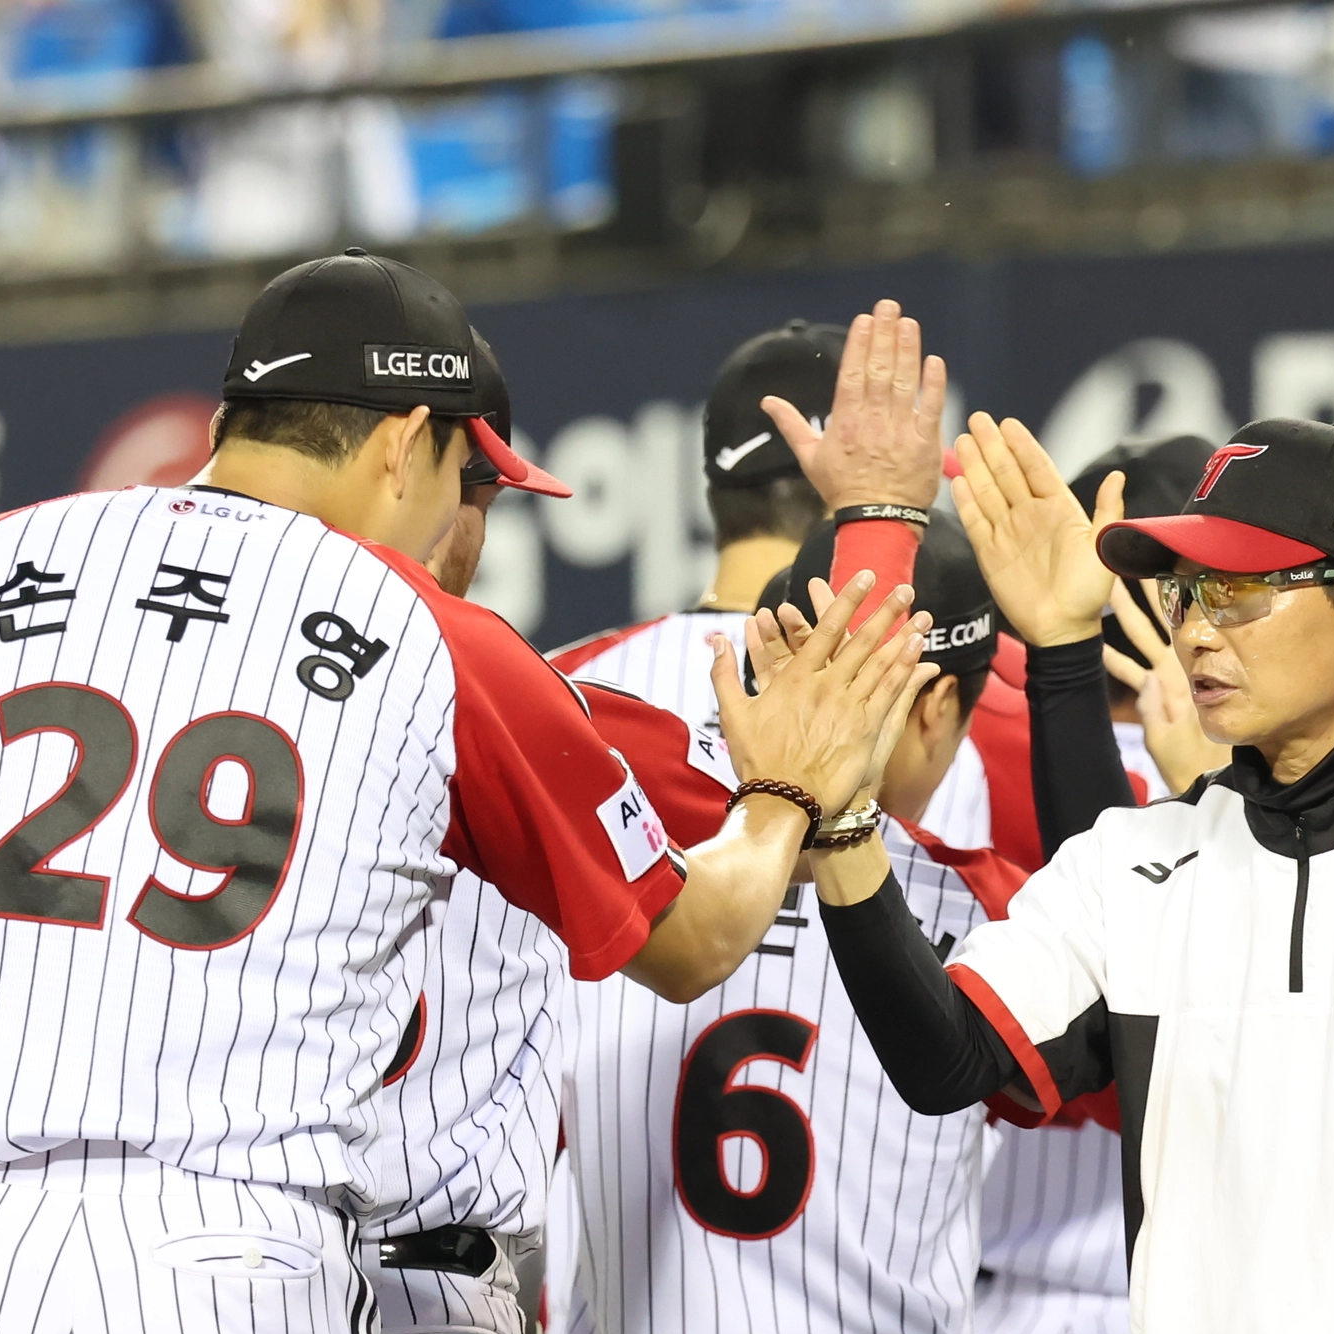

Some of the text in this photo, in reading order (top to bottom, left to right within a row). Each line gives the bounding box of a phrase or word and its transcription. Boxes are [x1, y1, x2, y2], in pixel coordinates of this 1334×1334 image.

[371, 350, 470, 380] LGE.COM
[199, 503, 231, 519] LG
[921, 612, 991, 652] E.COM
[673, 1007, 819, 1241] 6
